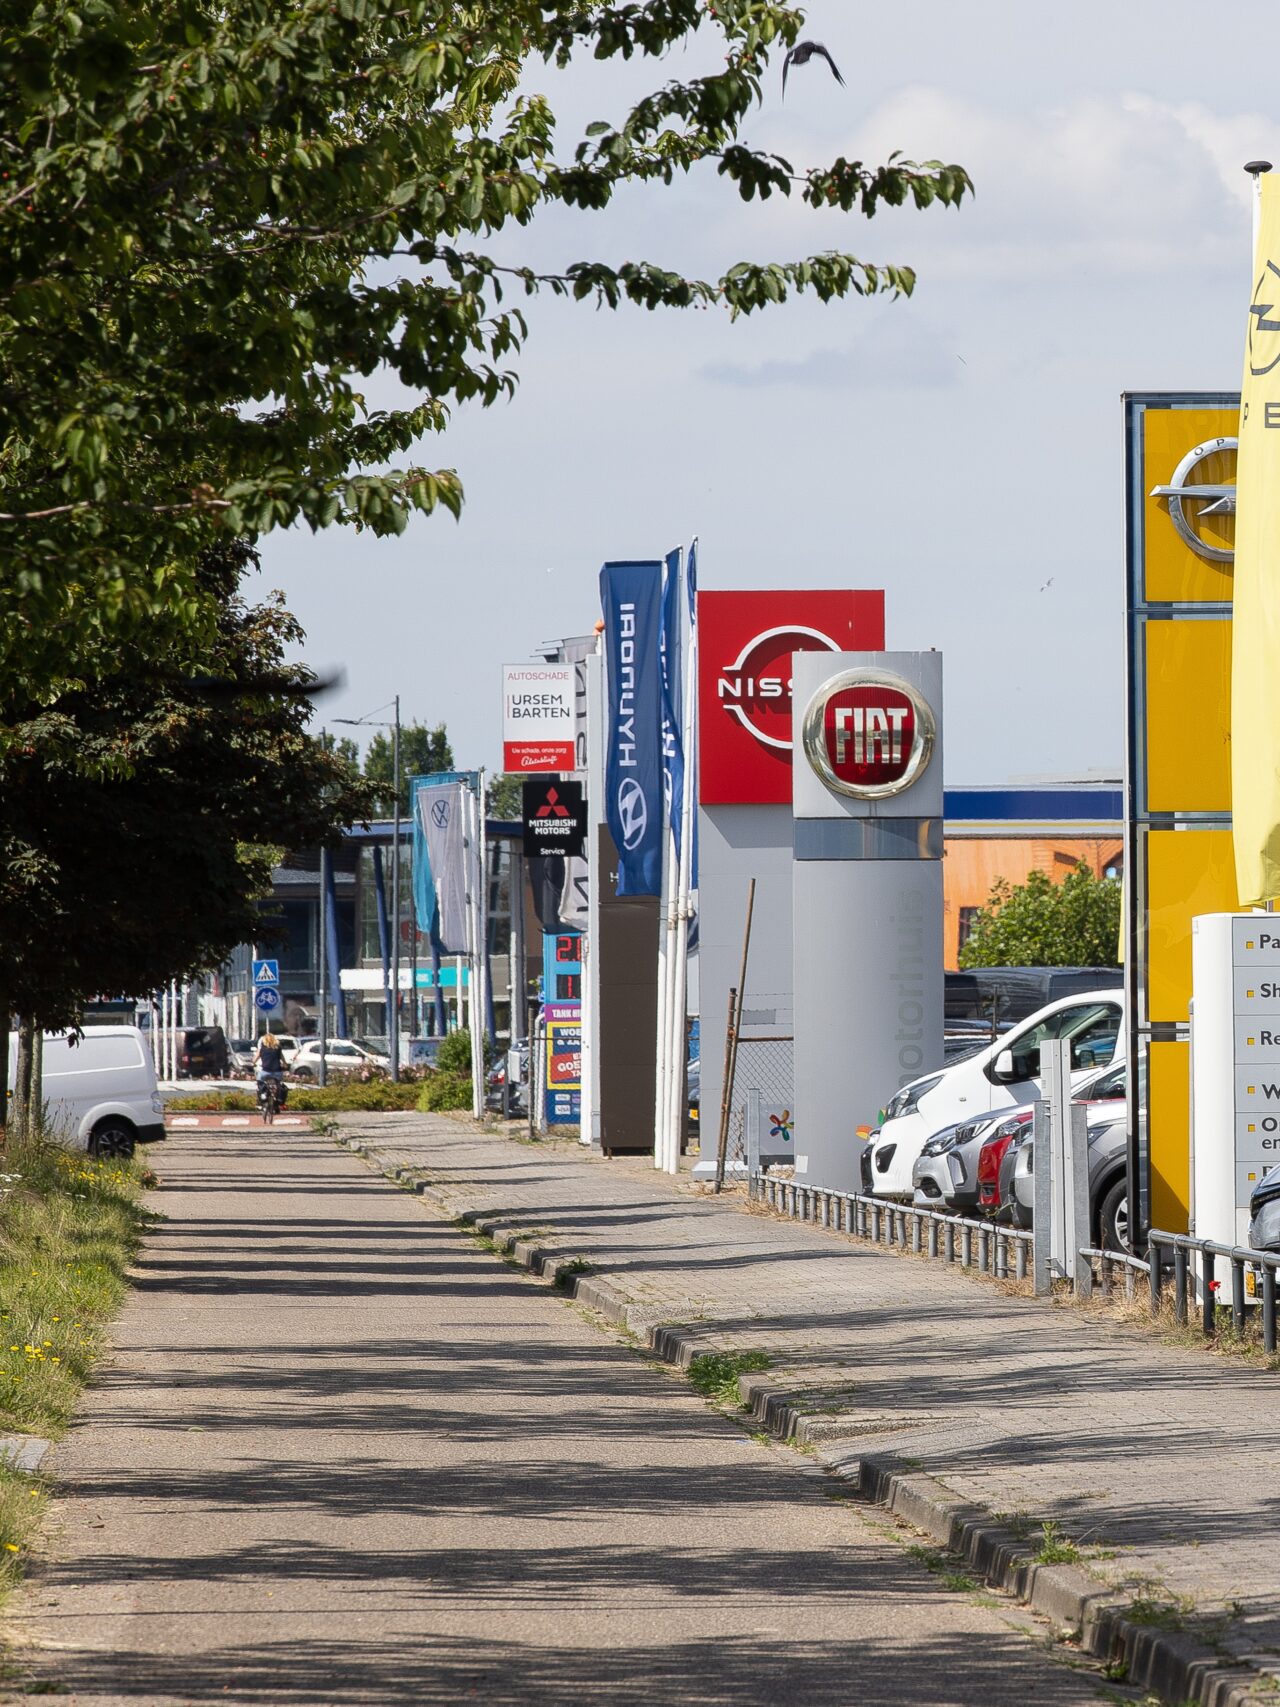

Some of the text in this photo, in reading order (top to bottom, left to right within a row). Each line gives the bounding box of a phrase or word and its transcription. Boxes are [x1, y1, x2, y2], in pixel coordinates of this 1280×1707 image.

[507, 671, 570, 681] AUTOSCHADE
[512, 694, 563, 705] URSEM
[512, 707, 571, 718] BARTEN
[835, 707, 908, 764] FIAT
[528, 819, 577, 828] MITSUBISHI
[535, 827, 571, 835] MOTORS
